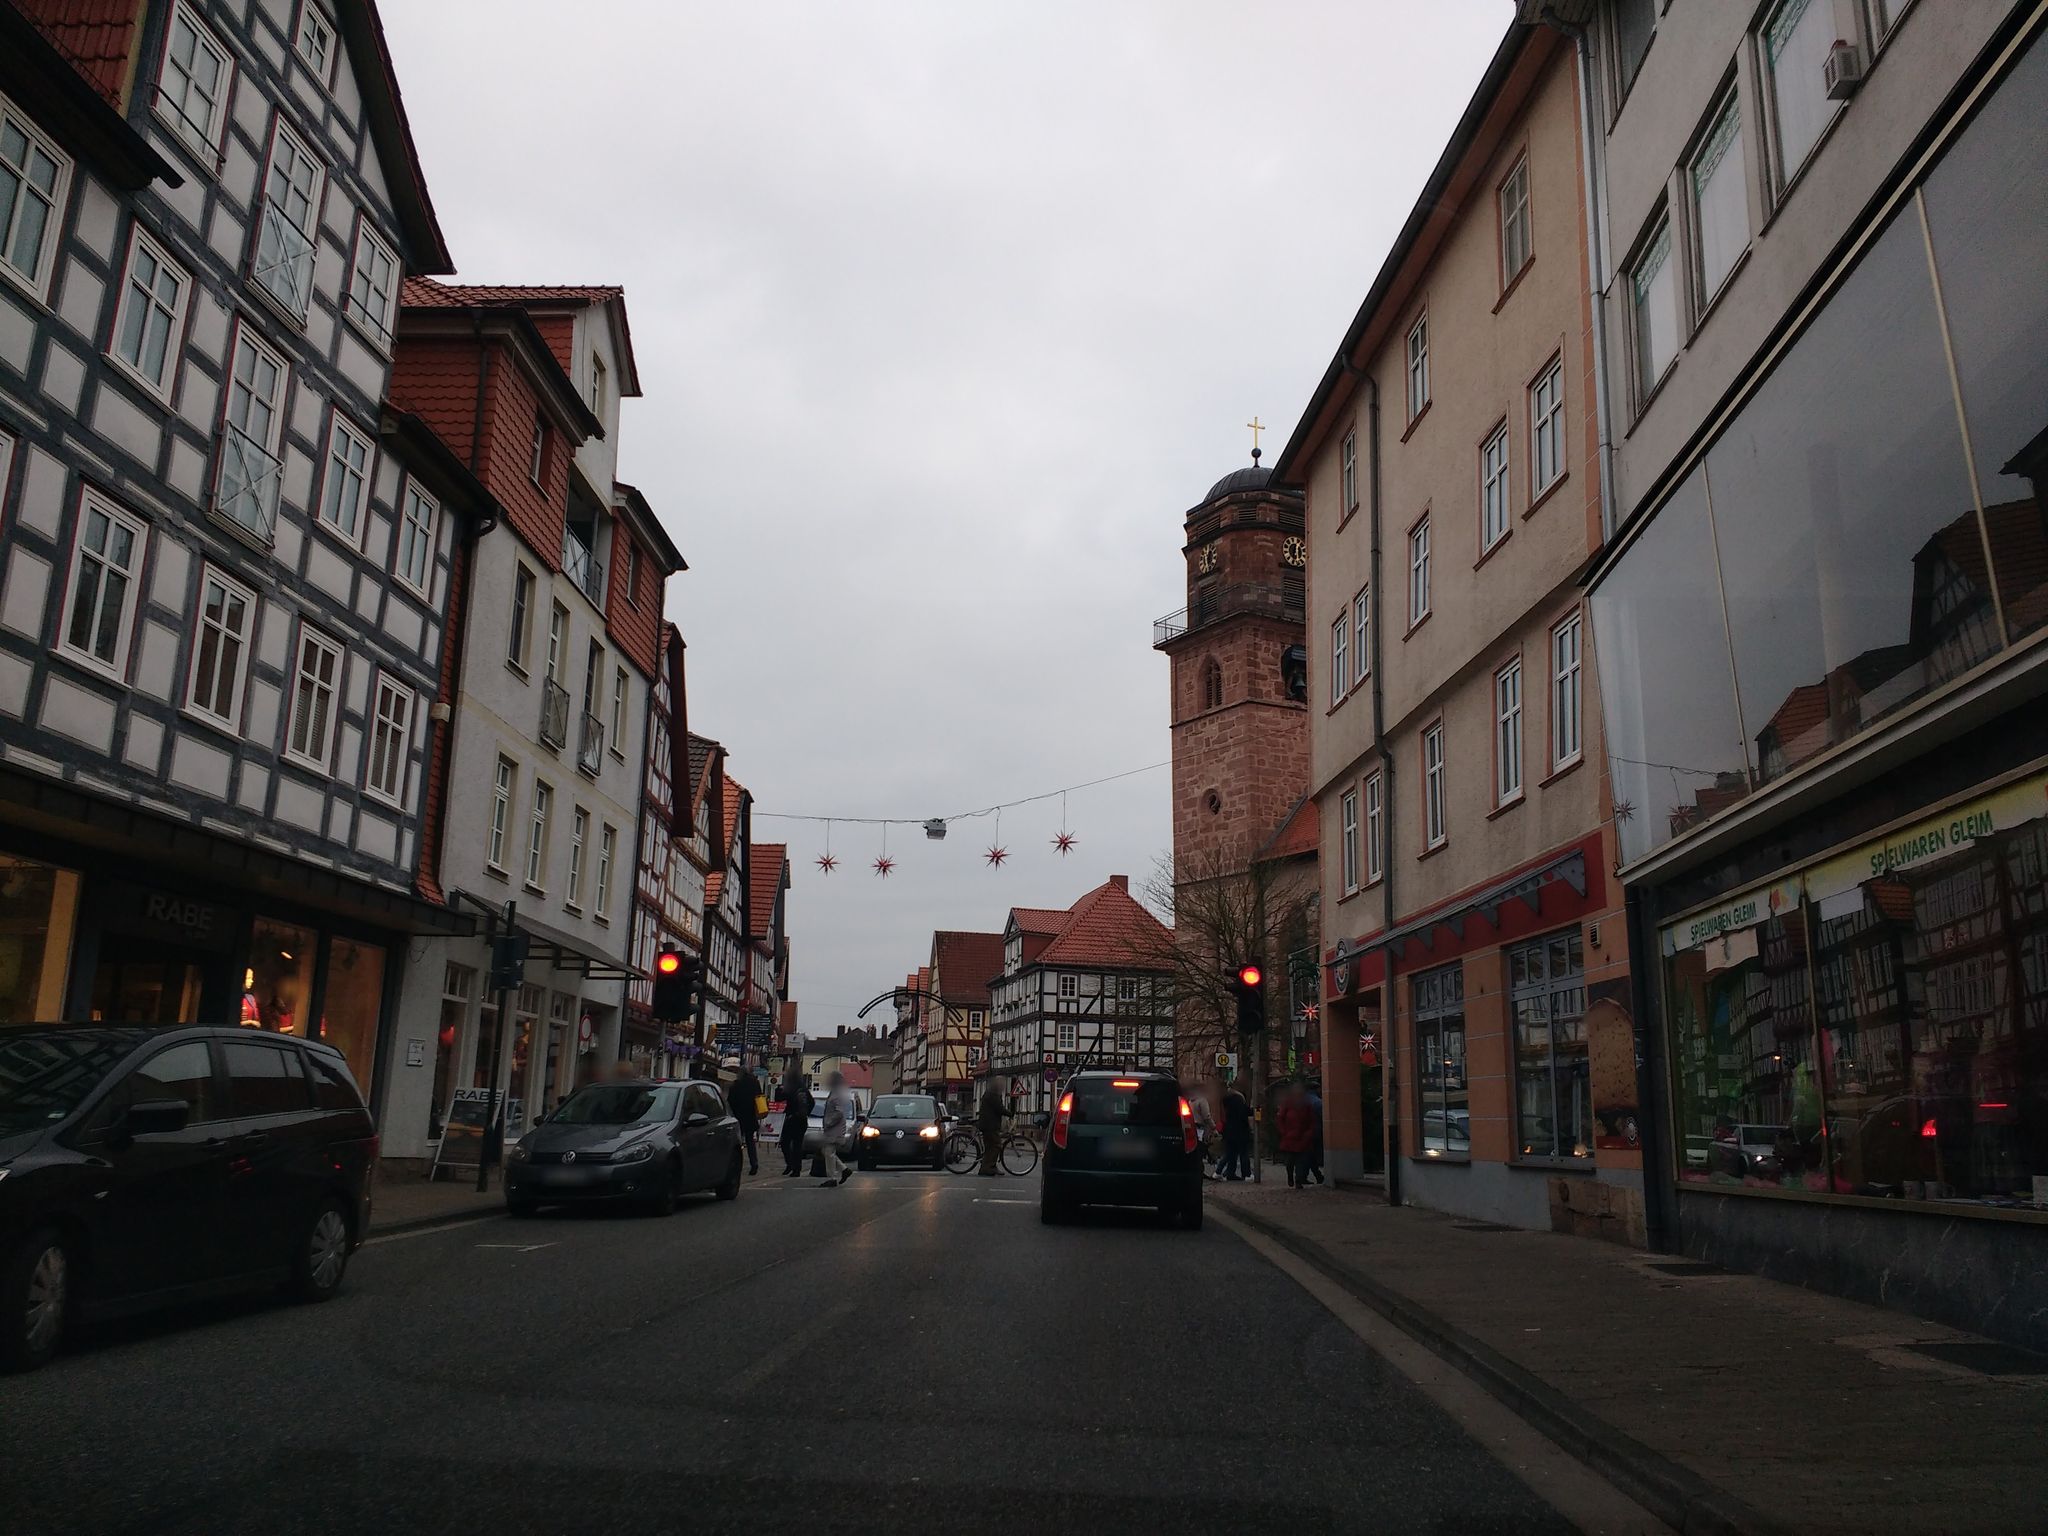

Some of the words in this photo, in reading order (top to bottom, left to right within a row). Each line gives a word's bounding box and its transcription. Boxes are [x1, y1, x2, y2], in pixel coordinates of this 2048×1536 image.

[1870, 827, 1946, 876] SPIELWAREN
[1949, 808, 1993, 846] GLEIM
[147, 894, 213, 931] RABE
[1690, 910, 1732, 941] SPIELWAREN
[1733, 901, 1758, 925] GLEIM
[454, 1089, 503, 1104] RABE
